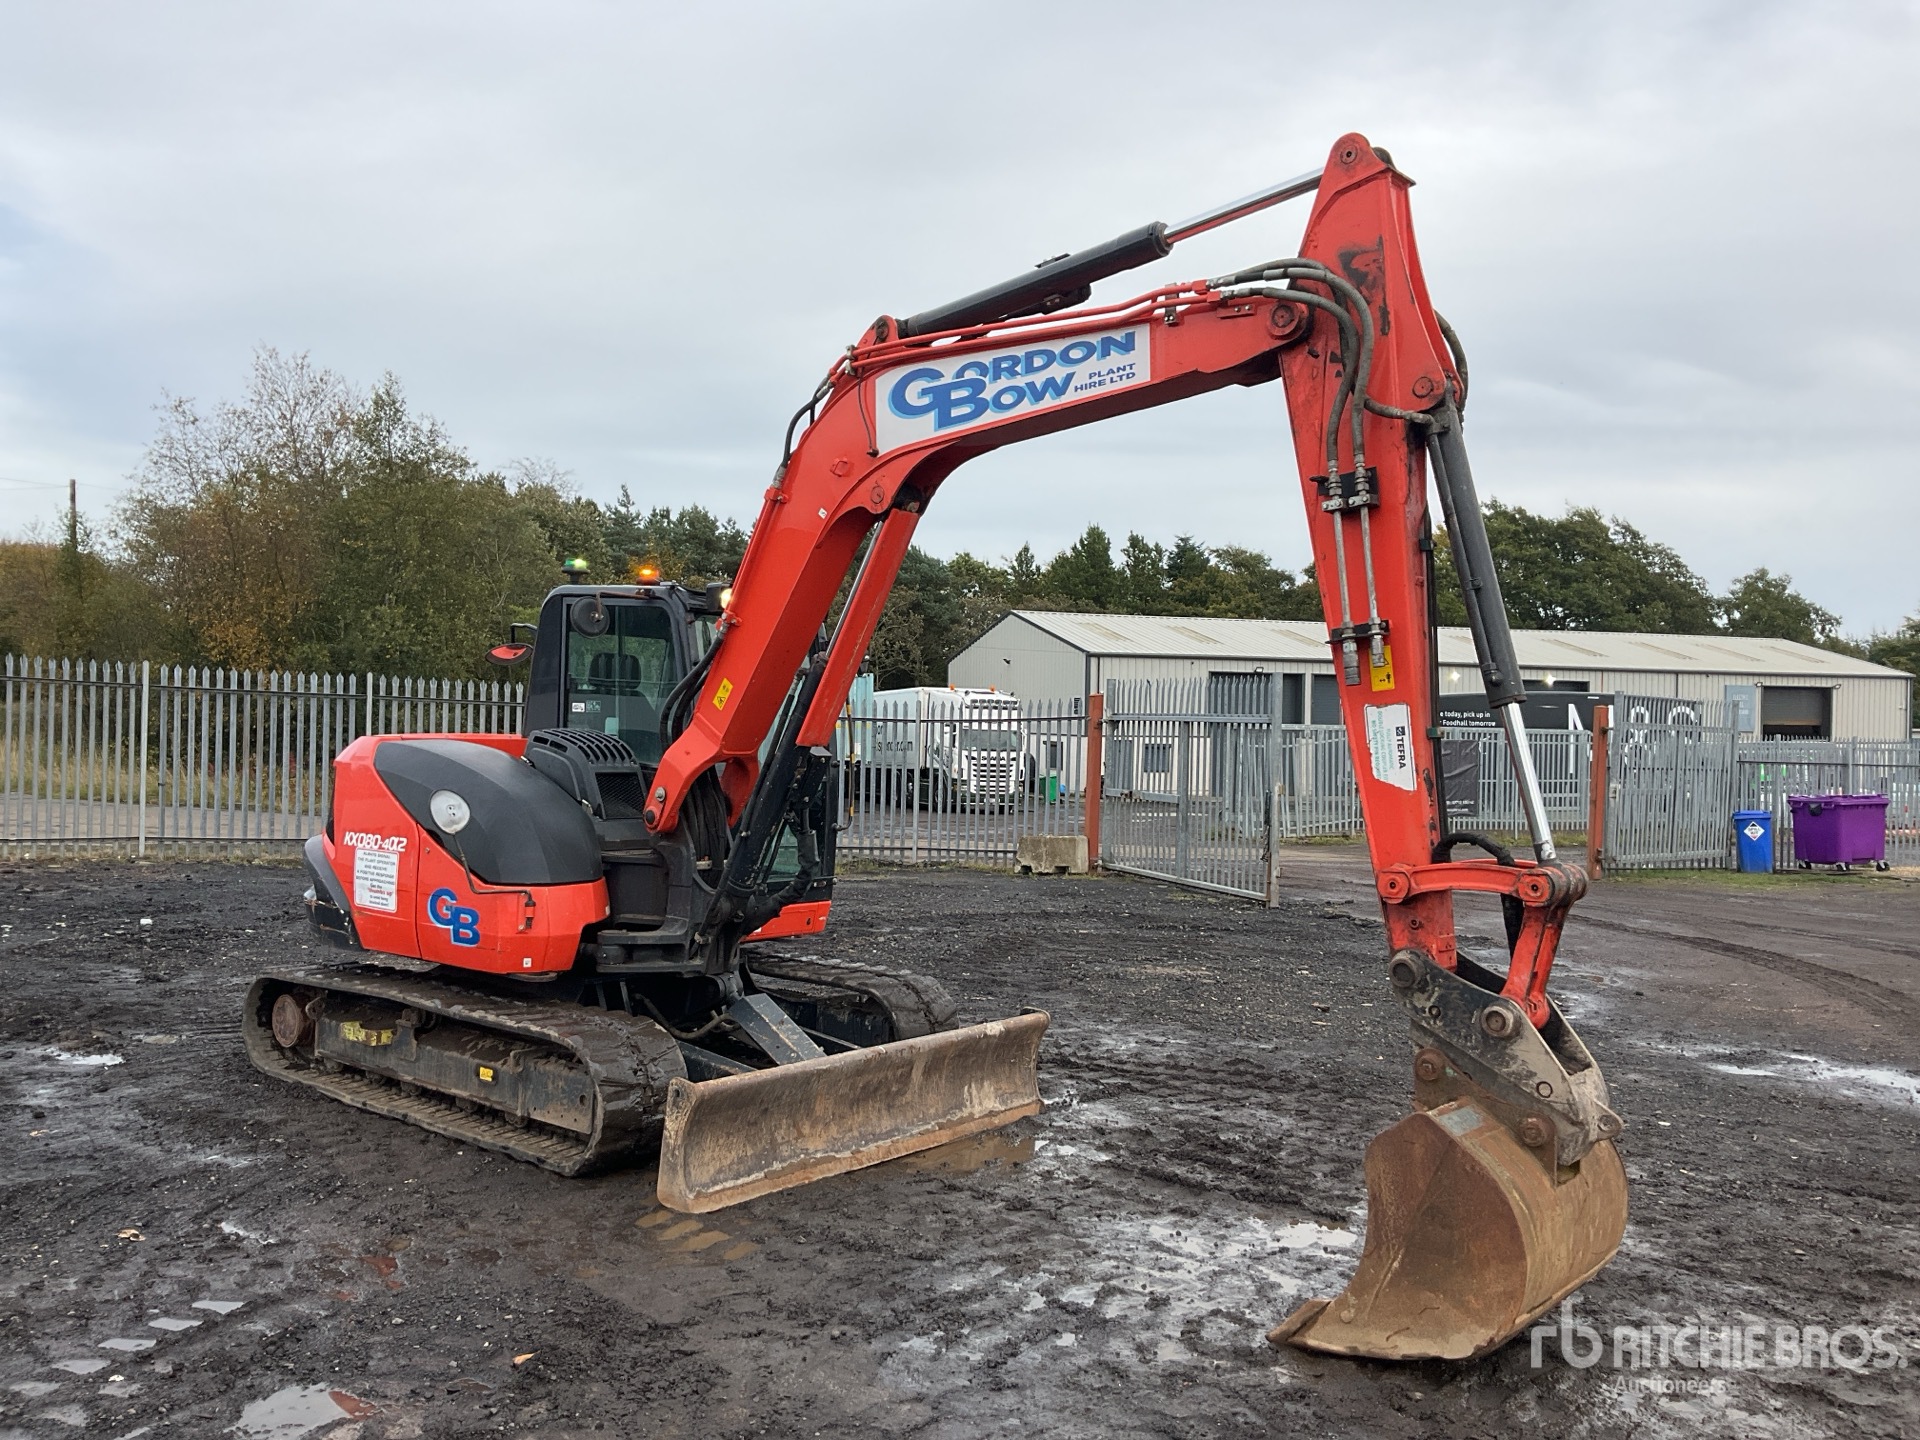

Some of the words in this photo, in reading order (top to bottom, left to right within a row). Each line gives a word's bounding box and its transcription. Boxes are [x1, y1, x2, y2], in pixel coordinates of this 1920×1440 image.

[888, 331, 1136, 418] GORDON
[1074, 377, 1107, 393] HIRE
[1109, 371, 1136, 384] LTD
[1089, 363, 1136, 380] PLANT
[1444, 710, 1463, 719] today,
[1463, 710, 1475, 719] pick
[1397, 737, 1407, 769] TEFRA
[427, 886, 481, 948] GB
